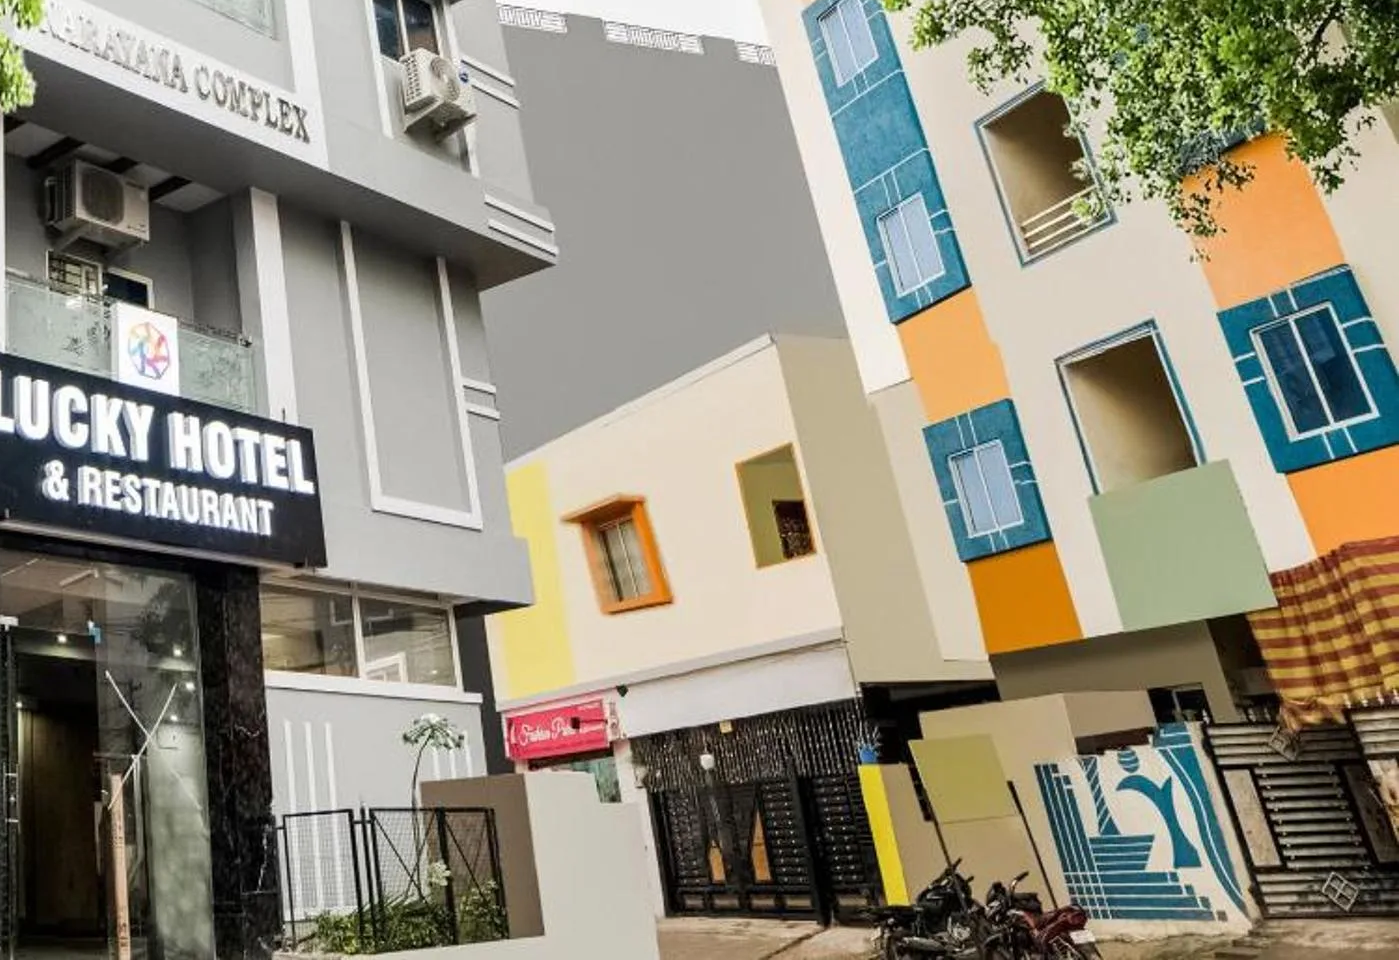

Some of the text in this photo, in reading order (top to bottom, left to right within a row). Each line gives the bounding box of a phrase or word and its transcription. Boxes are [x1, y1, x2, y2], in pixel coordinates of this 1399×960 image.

[194, 62, 311, 143] COMPLEX
[167, 411, 315, 494] HOTEL
[41, 459, 275, 538] & RESTAURANT
